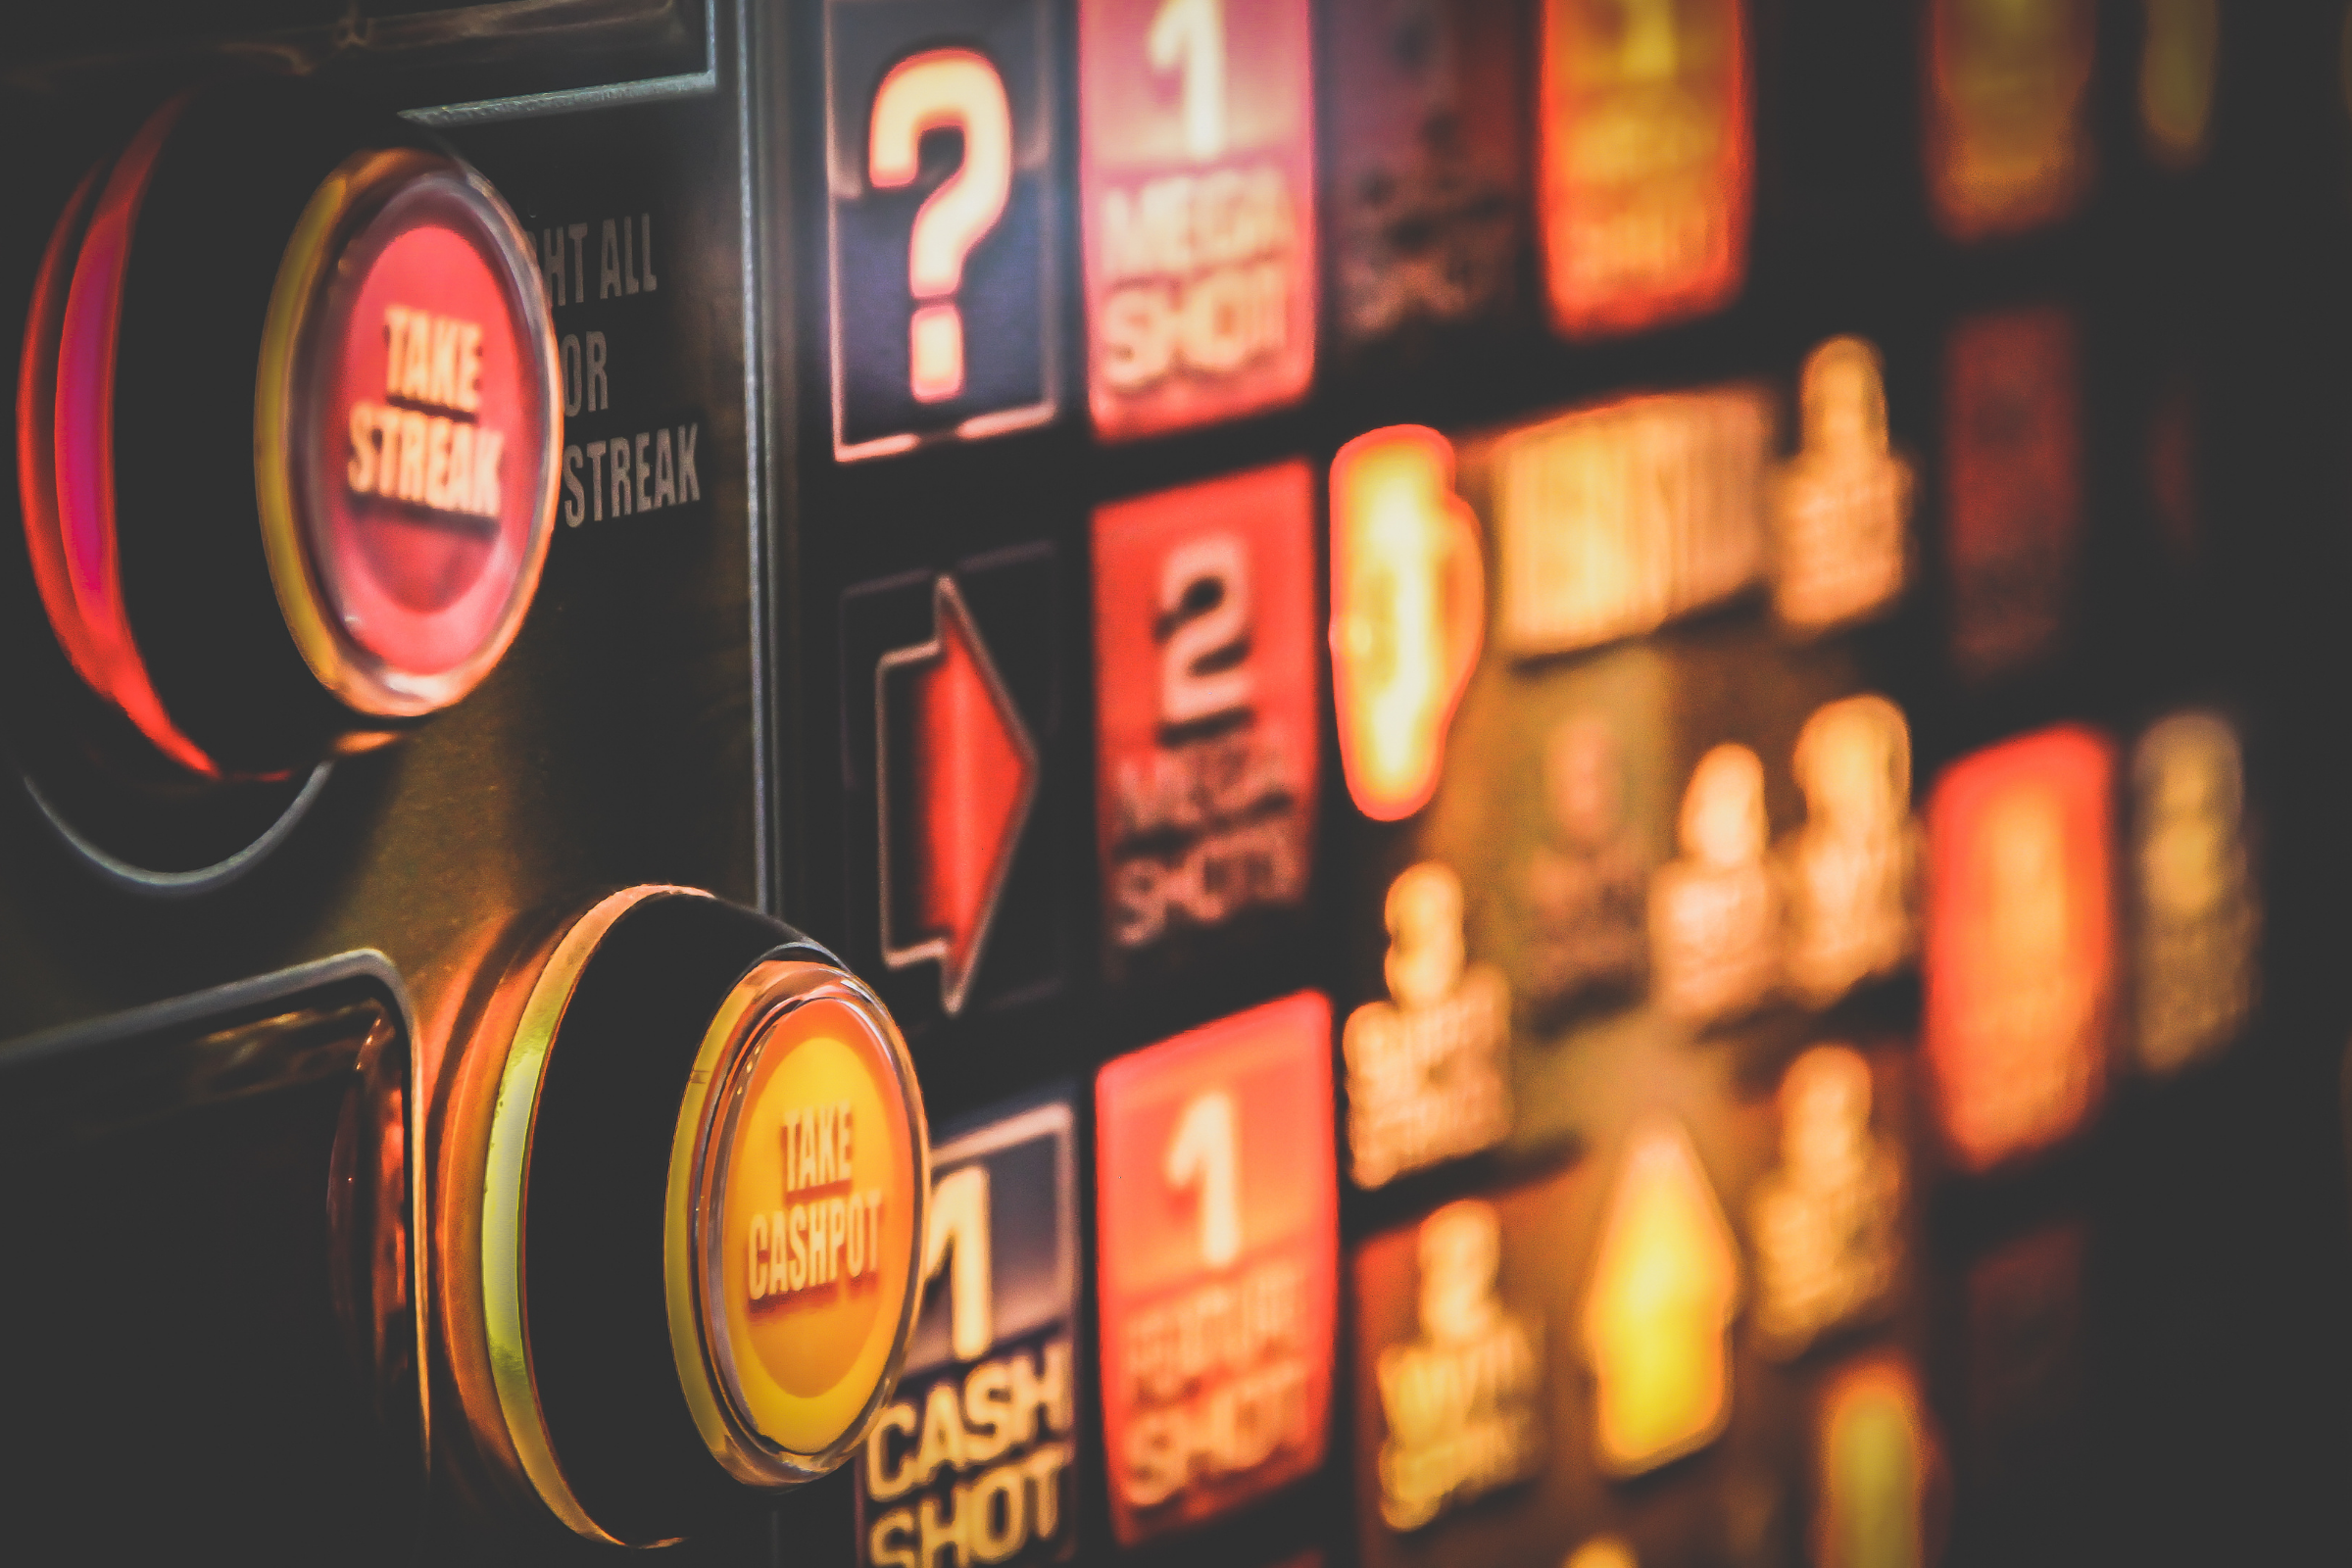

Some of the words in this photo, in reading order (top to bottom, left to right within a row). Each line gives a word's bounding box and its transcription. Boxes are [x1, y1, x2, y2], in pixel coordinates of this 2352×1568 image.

[600, 212, 658, 300] ALL
[384, 304, 483, 413] TAKE
[562, 331, 609, 416] OR
[1102, 265, 1290, 386] SHOT
[348, 403, 506, 516] STREAK
[563, 422, 701, 528] STREAK
[1159, 534, 1254, 720] 2
[783, 1099, 851, 1193] TAKE
[1164, 1091, 1242, 1267] 1
[748, 1188, 881, 1300] CASHPOT
[926, 1166, 992, 1361] 1
[867, 1343, 1072, 1502] CASH
[868, 1446, 1065, 1568] SHOT
